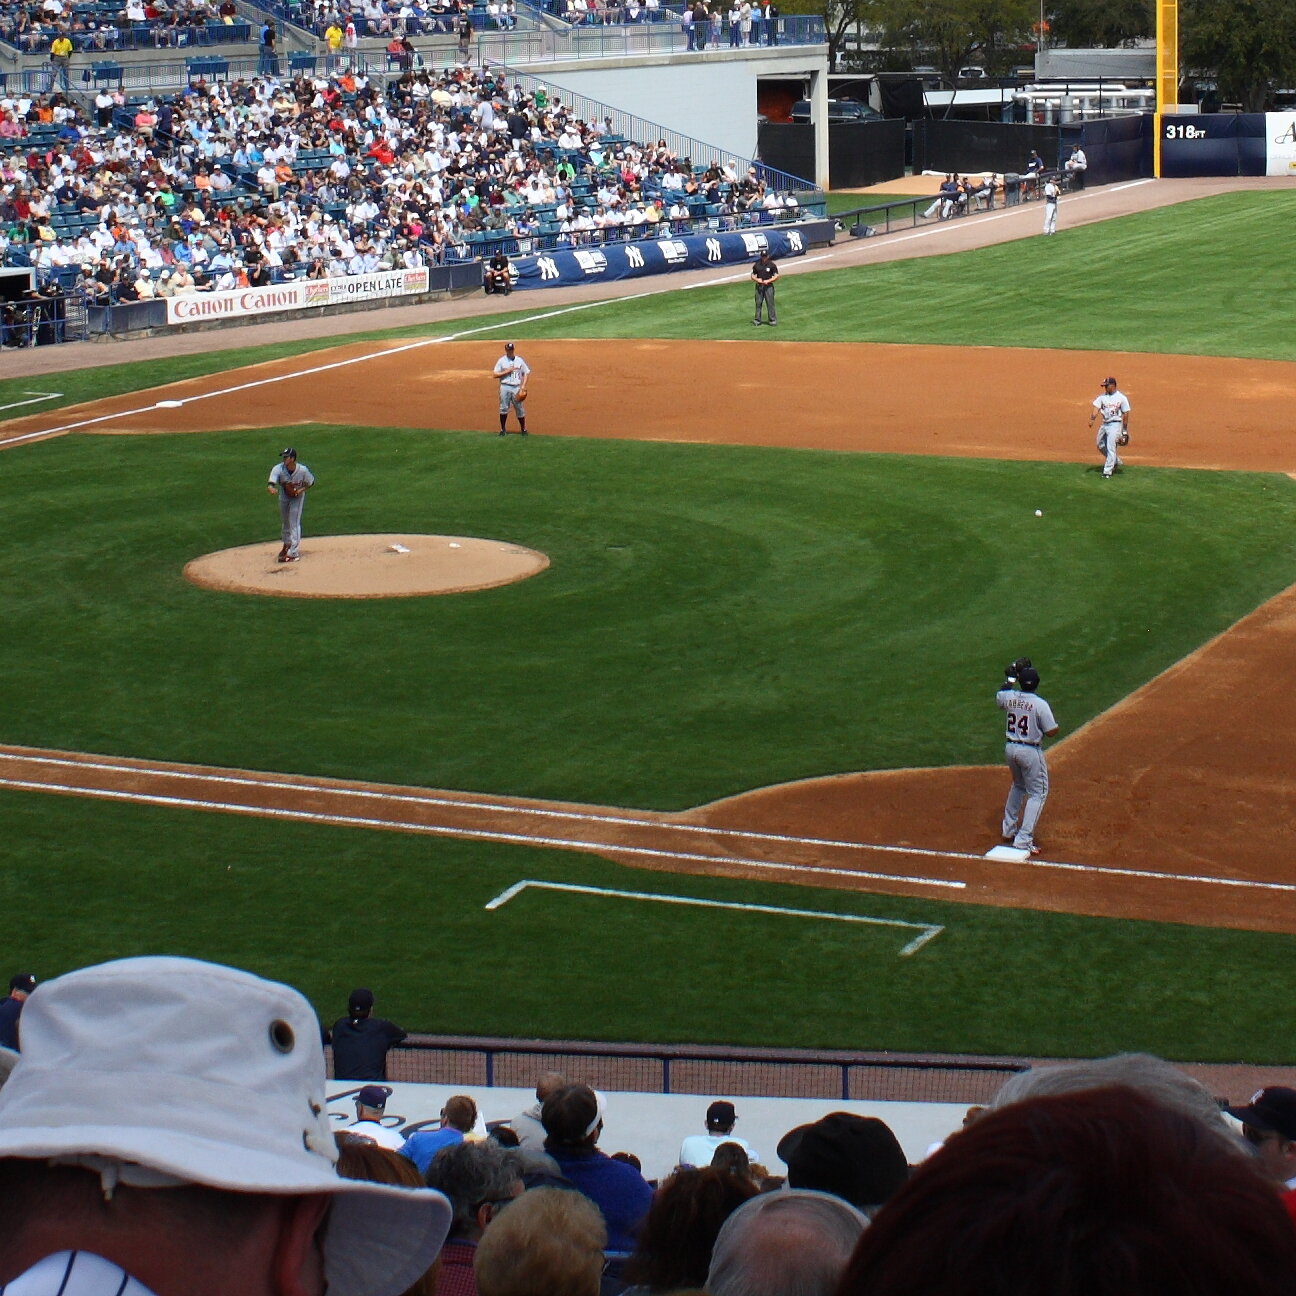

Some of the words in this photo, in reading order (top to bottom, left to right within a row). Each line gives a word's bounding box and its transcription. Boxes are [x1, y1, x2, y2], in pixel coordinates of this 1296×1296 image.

[347, 280, 376, 294] OPEN
[378, 277, 402, 291] LATE
[173, 297, 234, 318] Canon
[240, 289, 298, 310] Canon
[1007, 711, 1030, 737] 24
